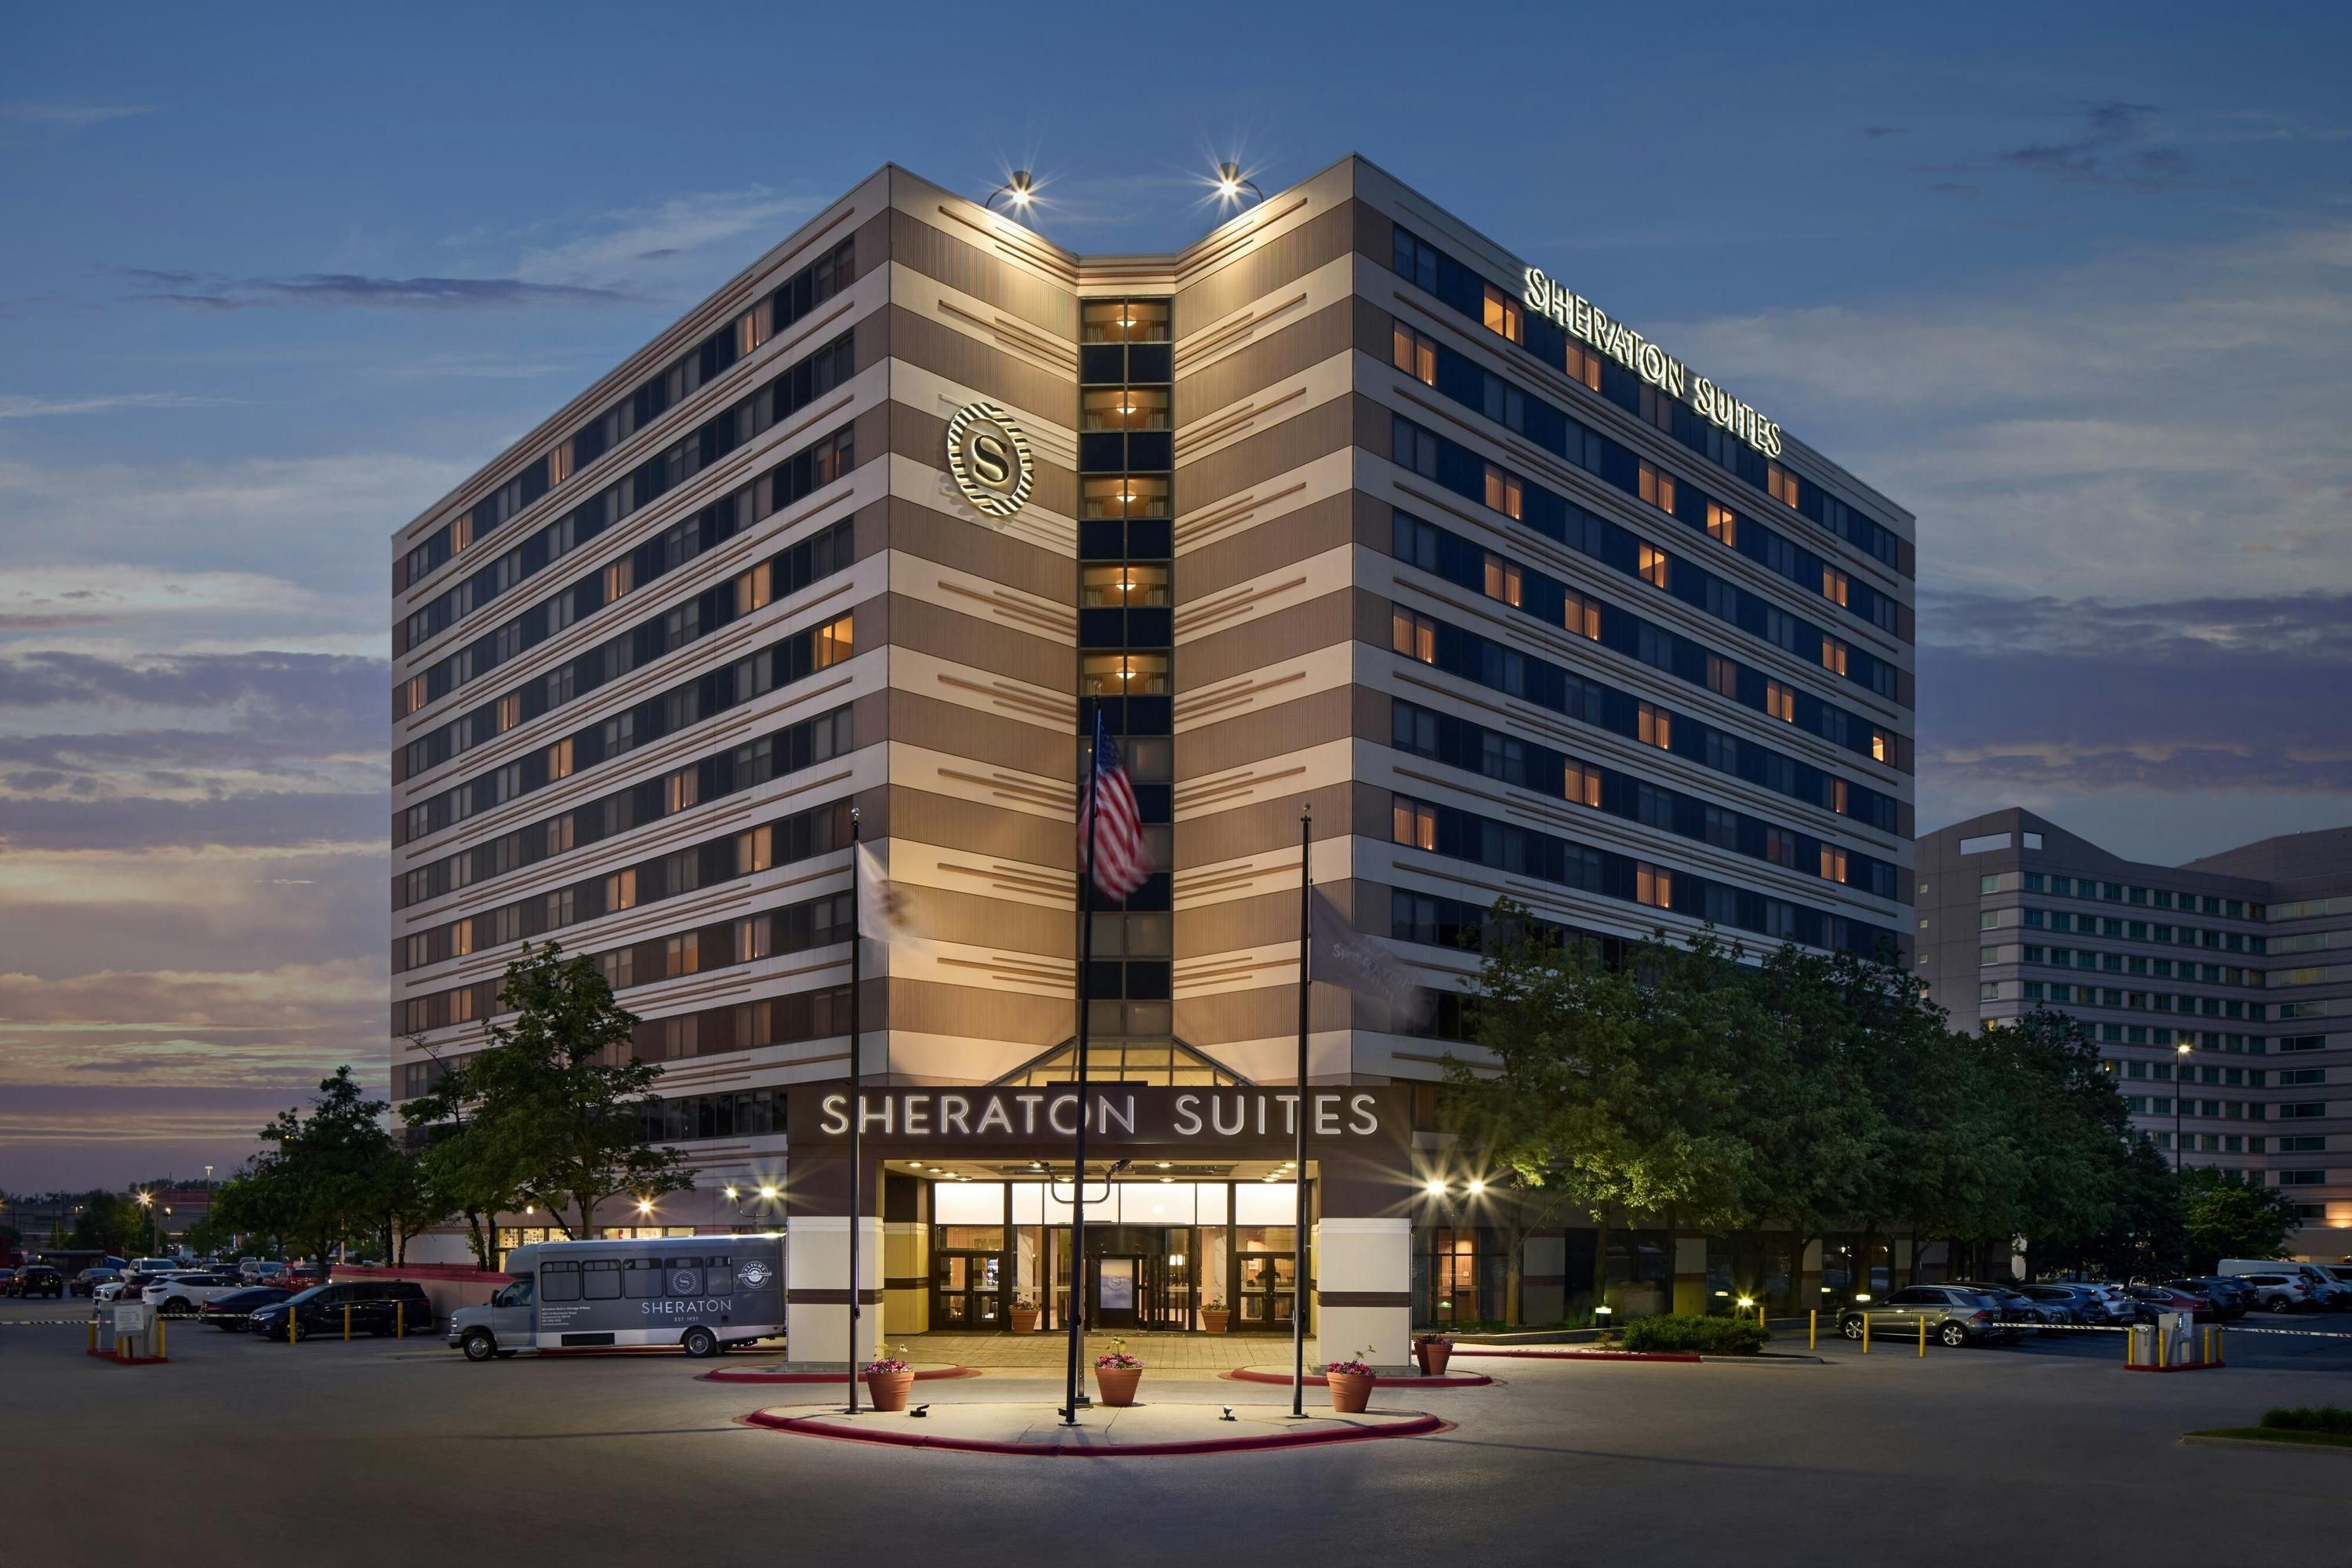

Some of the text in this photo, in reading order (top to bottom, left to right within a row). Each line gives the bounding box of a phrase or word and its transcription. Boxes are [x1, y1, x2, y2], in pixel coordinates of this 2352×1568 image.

[1526, 267, 1782, 456] SHERATON SUITES
[972, 434, 1010, 484] S
[820, 1094, 1378, 1135] SHERATON SUITES
[679, 1276, 690, 1287] S
[641, 1299, 732, 1315] SHERATON
